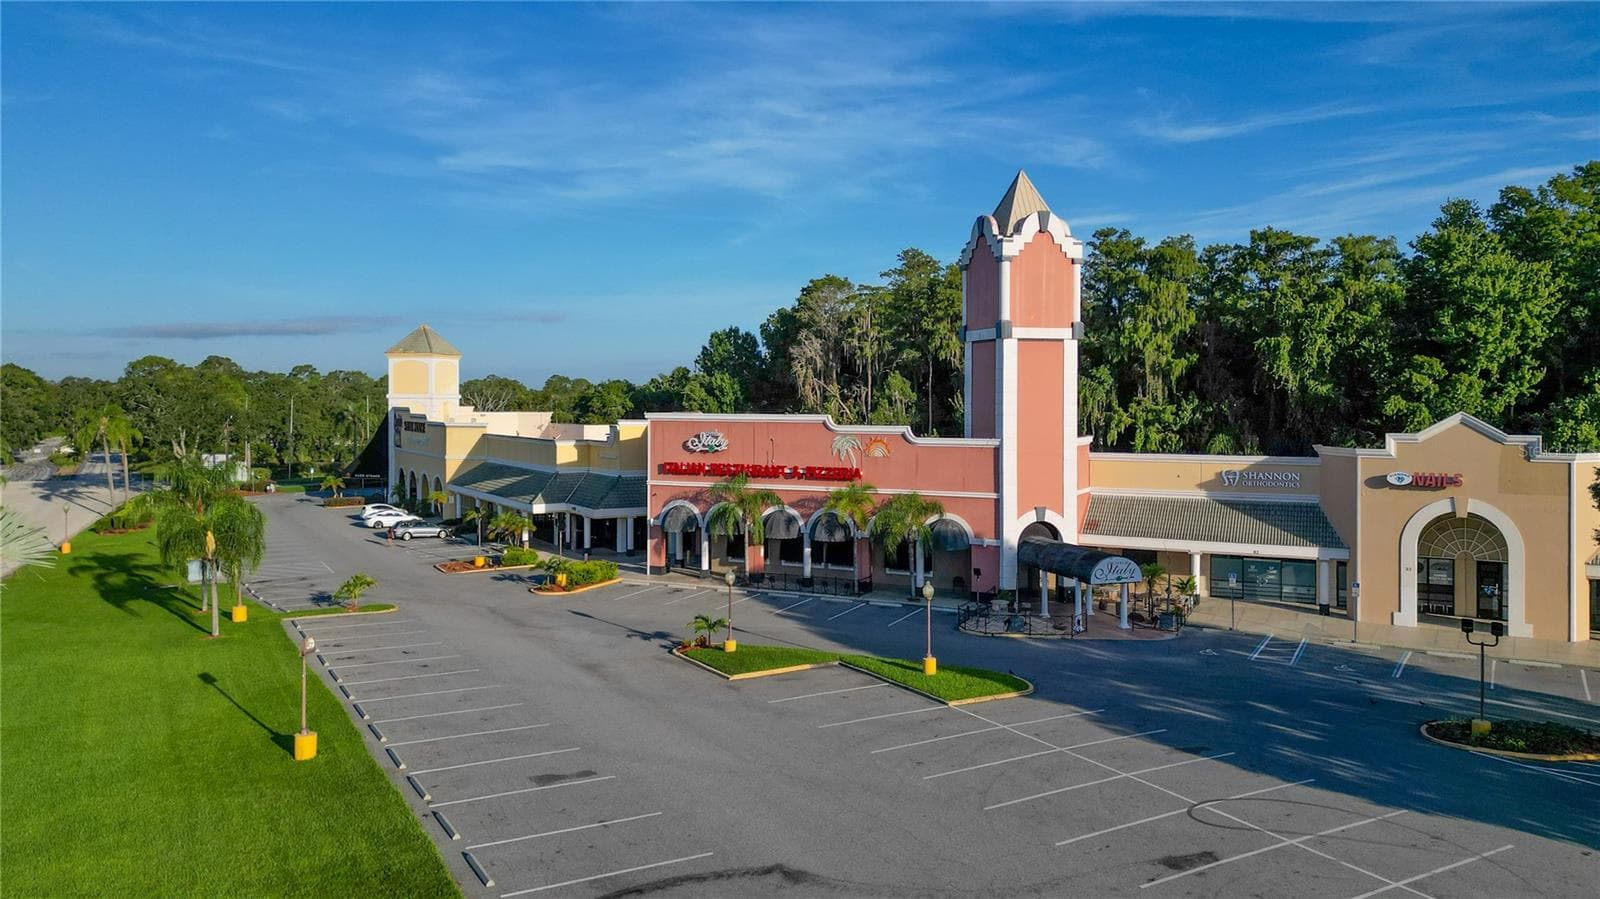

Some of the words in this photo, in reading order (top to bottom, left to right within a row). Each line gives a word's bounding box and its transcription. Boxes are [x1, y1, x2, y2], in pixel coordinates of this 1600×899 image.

[663, 462, 706, 475] ITALIAN
[806, 466, 862, 480] PIZZERIA
[1242, 472, 1300, 481] SHANNON
[1242, 480, 1301, 489] ORTHODONTICS
[1412, 472, 1463, 488] NAILS
[1094, 562, 1136, 581] Italy
